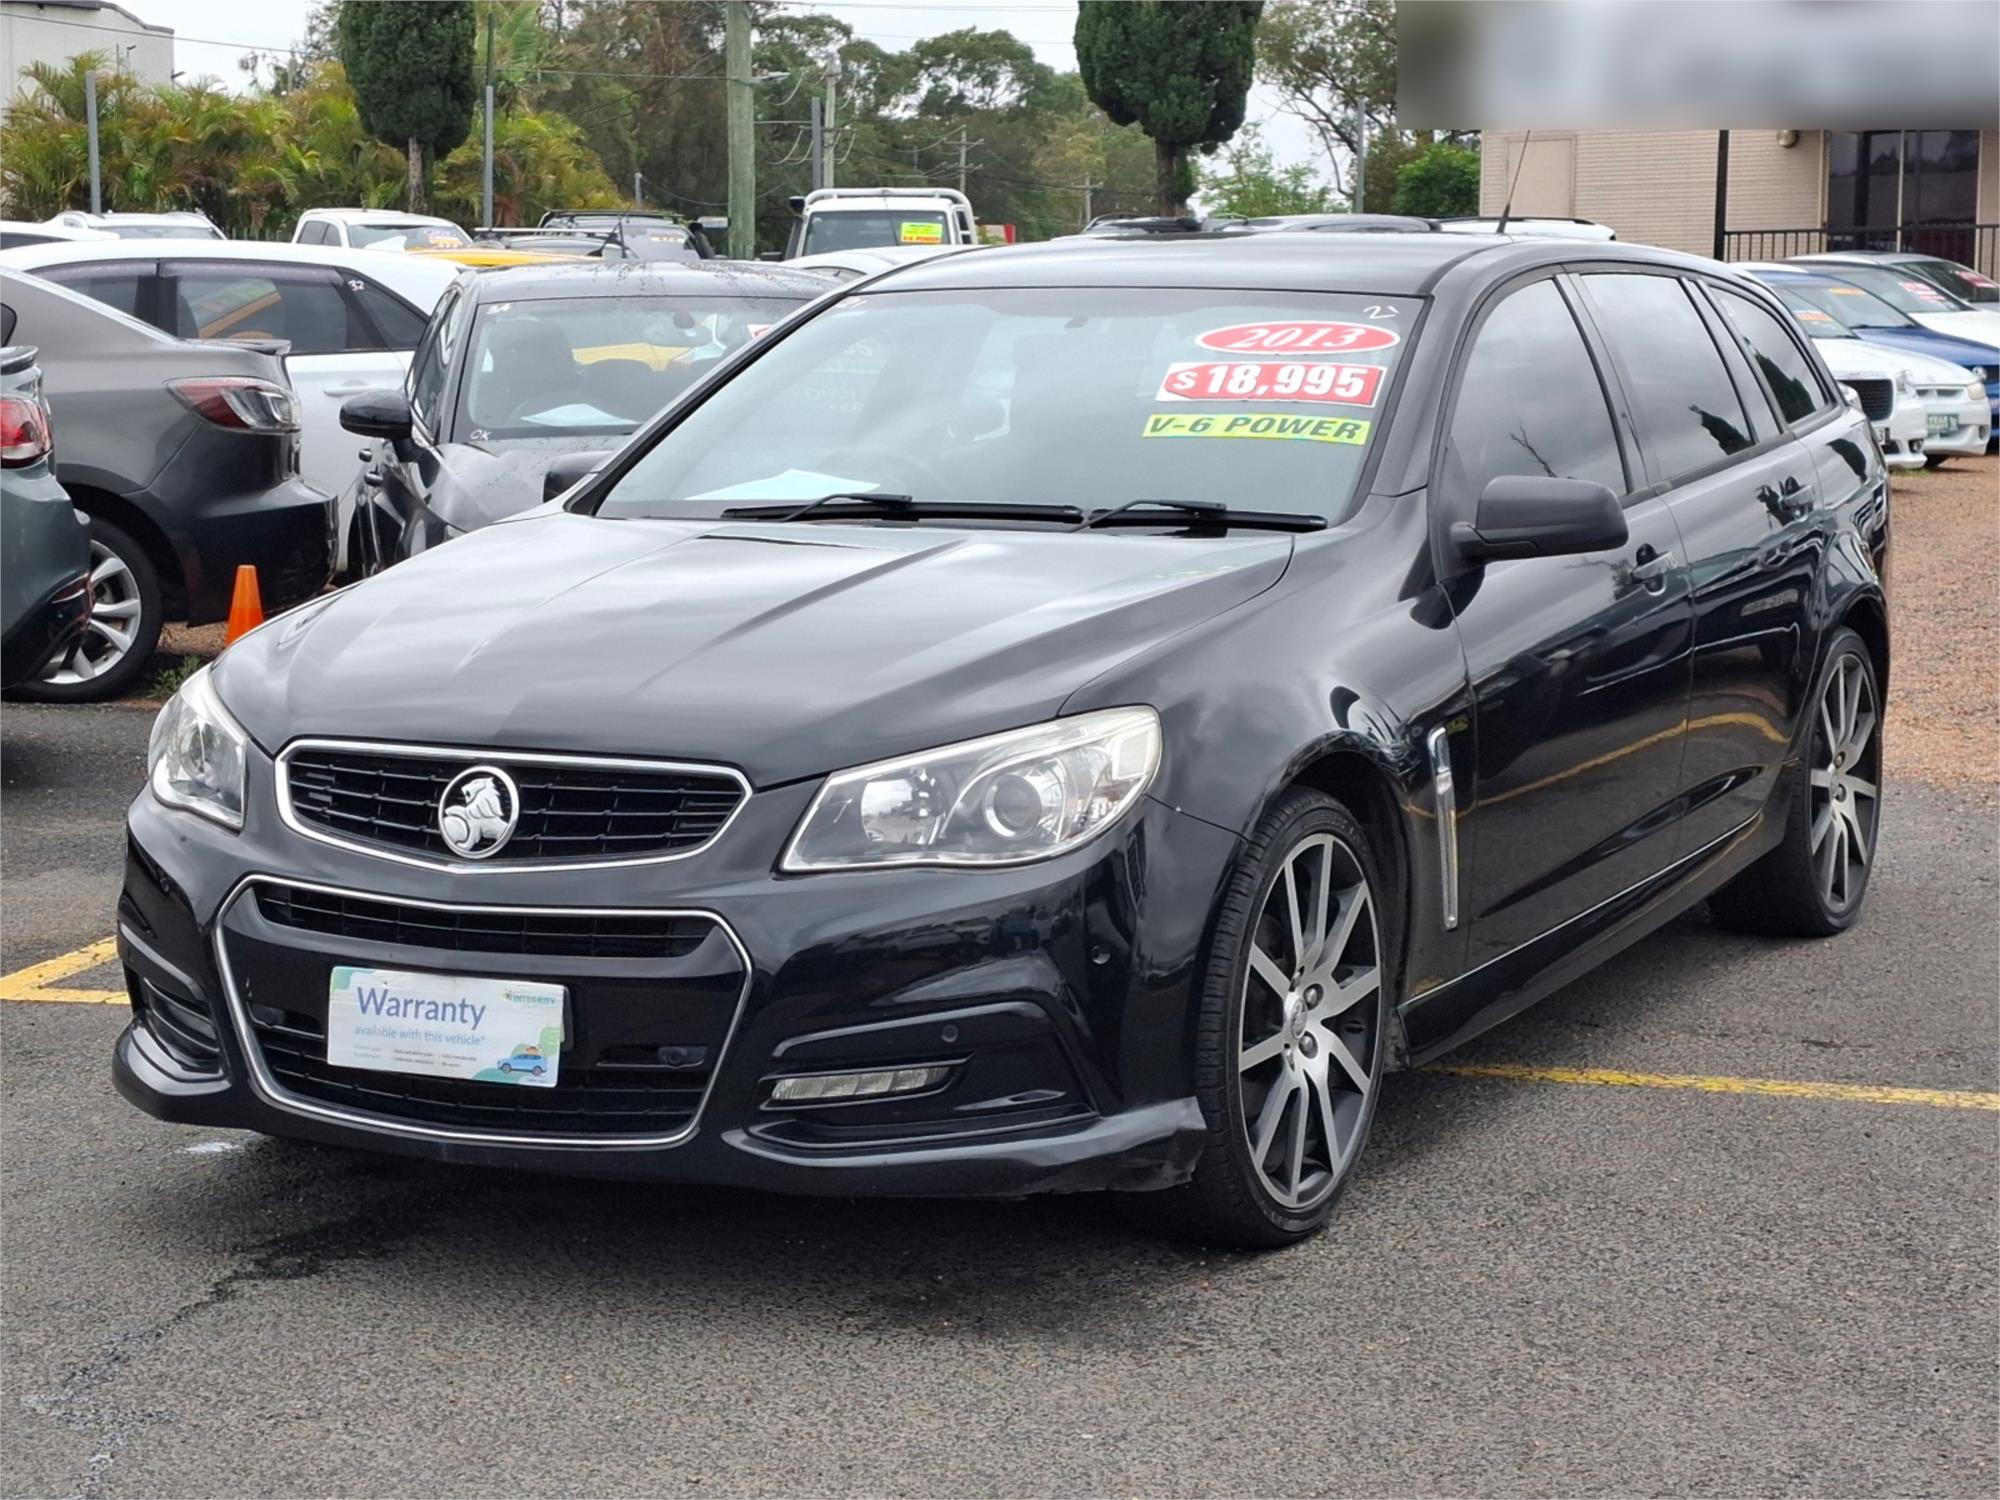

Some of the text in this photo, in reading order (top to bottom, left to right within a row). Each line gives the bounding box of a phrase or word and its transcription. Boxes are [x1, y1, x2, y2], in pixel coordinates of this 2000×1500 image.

[348, 280, 365, 291] 32
[1230, 326, 1368, 349] 2013
[1173, 365, 1368, 398] $18,995
[1150, 416, 1362, 439] V-6 POWER
[356, 986, 486, 1030] Warranty
[354, 1023, 397, 1039] available
[399, 1027, 422, 1041] with
[424, 1030, 443, 1042] this
